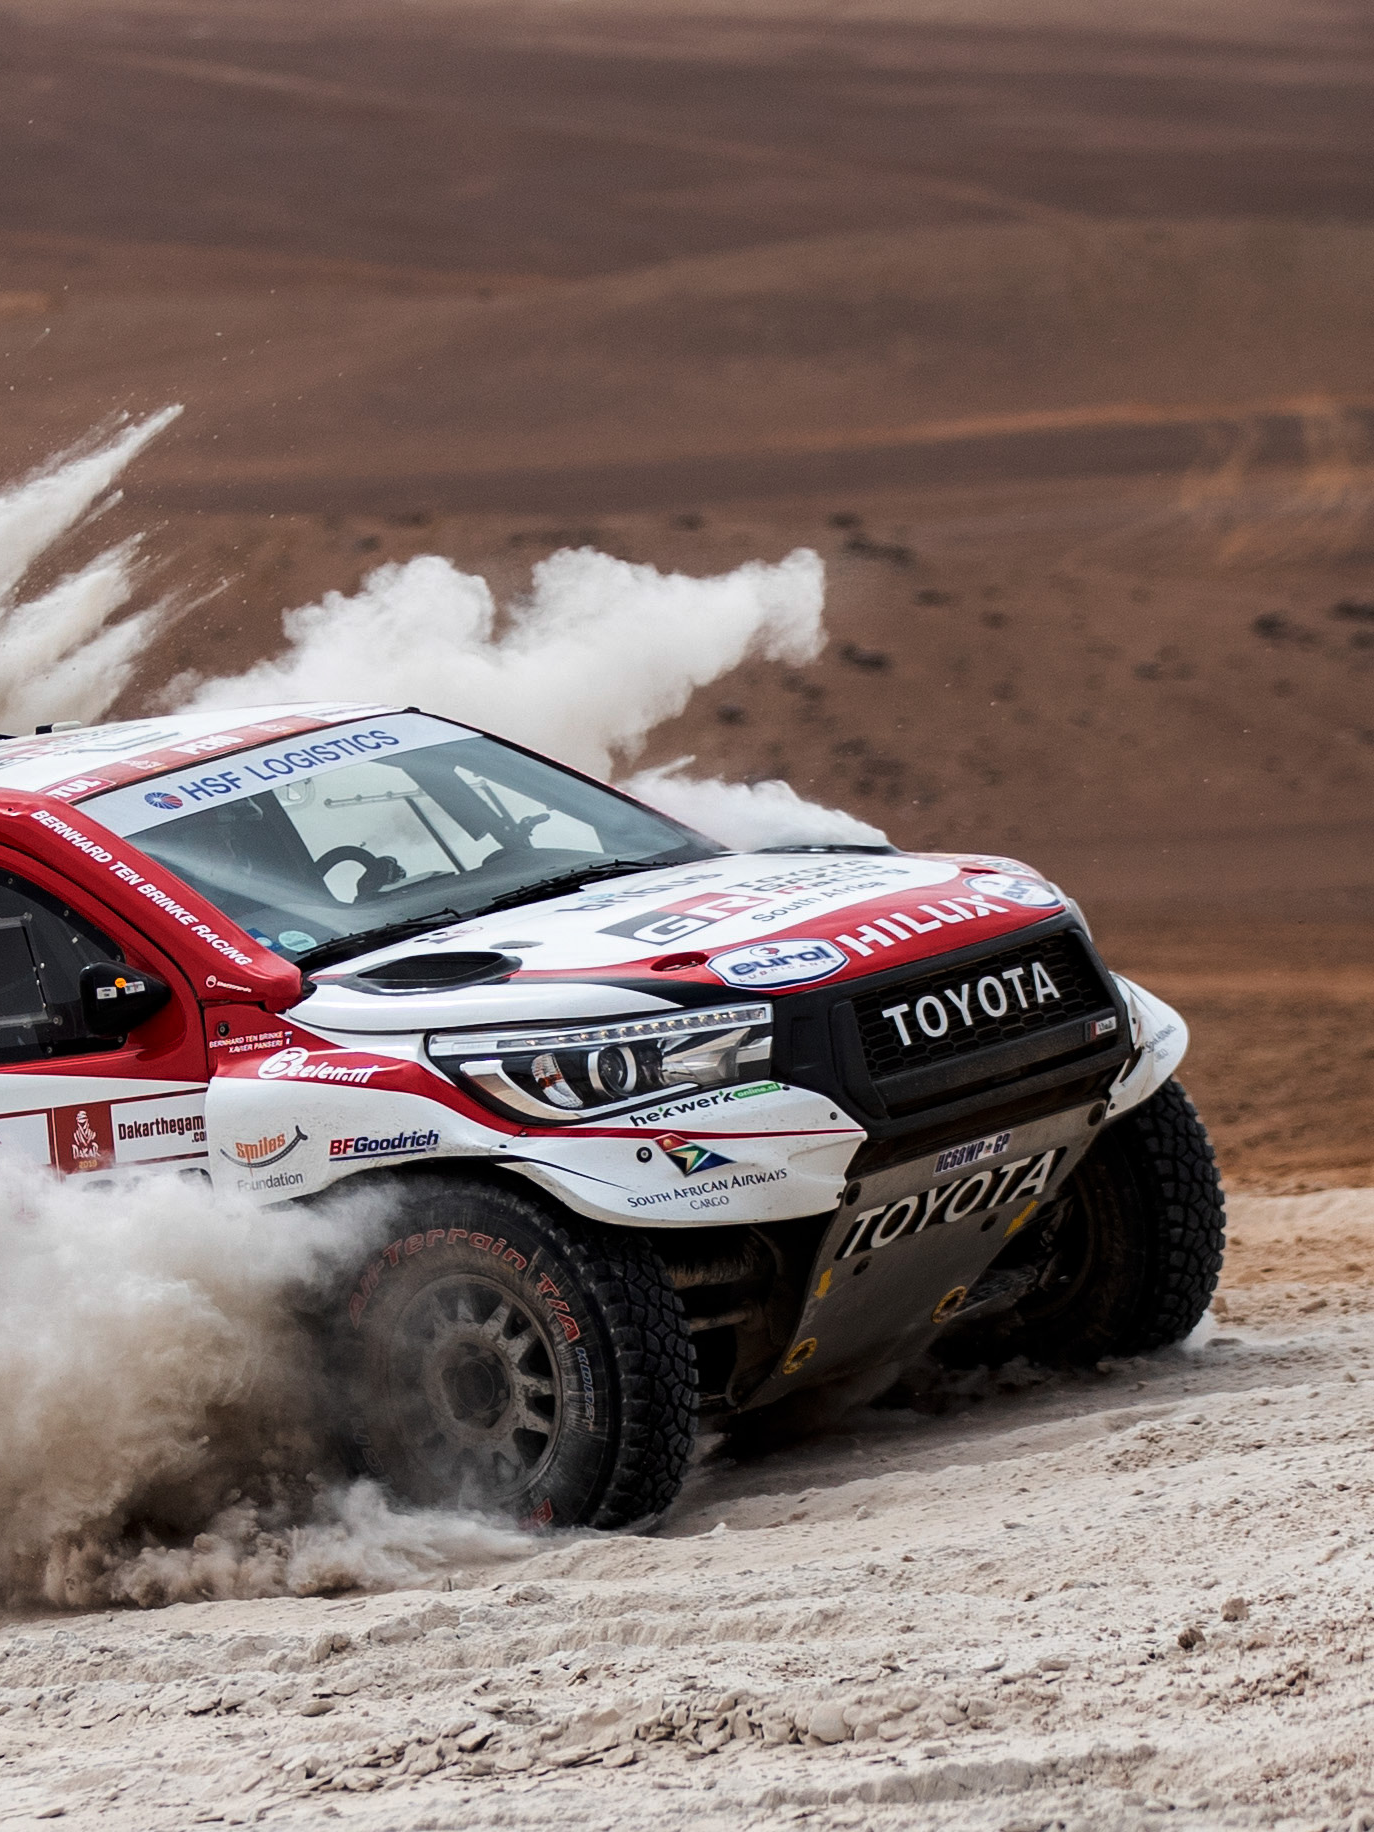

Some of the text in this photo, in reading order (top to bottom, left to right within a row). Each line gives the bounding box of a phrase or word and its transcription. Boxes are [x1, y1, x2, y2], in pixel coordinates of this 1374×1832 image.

[178, 729, 400, 801] HSF LOGISTICS
[45, 778, 101, 800] TUL
[30, 809, 253, 966] BERNHARD TEN BRINKE RACING
[725, 859, 869, 889] TOYOTA
[753, 864, 883, 892] GAZOO
[751, 881, 887, 922] South Africa
[835, 893, 1010, 957] HILUX
[729, 945, 834, 976] eurol
[882, 961, 1061, 1047] TOYOTA
[629, 1083, 779, 1127] hekwerk online.nl
[117, 1114, 206, 1141] Dakarthegam
[329, 1129, 440, 1156] BFGoodrich
[78, 1159, 98, 1169] 2019
[237, 1171, 304, 1193] Foundation
[627, 1167, 788, 1209] SOUTH AFRICAN AIRWAYS
[689, 1195, 730, 1211] CARGO
[842, 1149, 1058, 1259] TOYOTA
